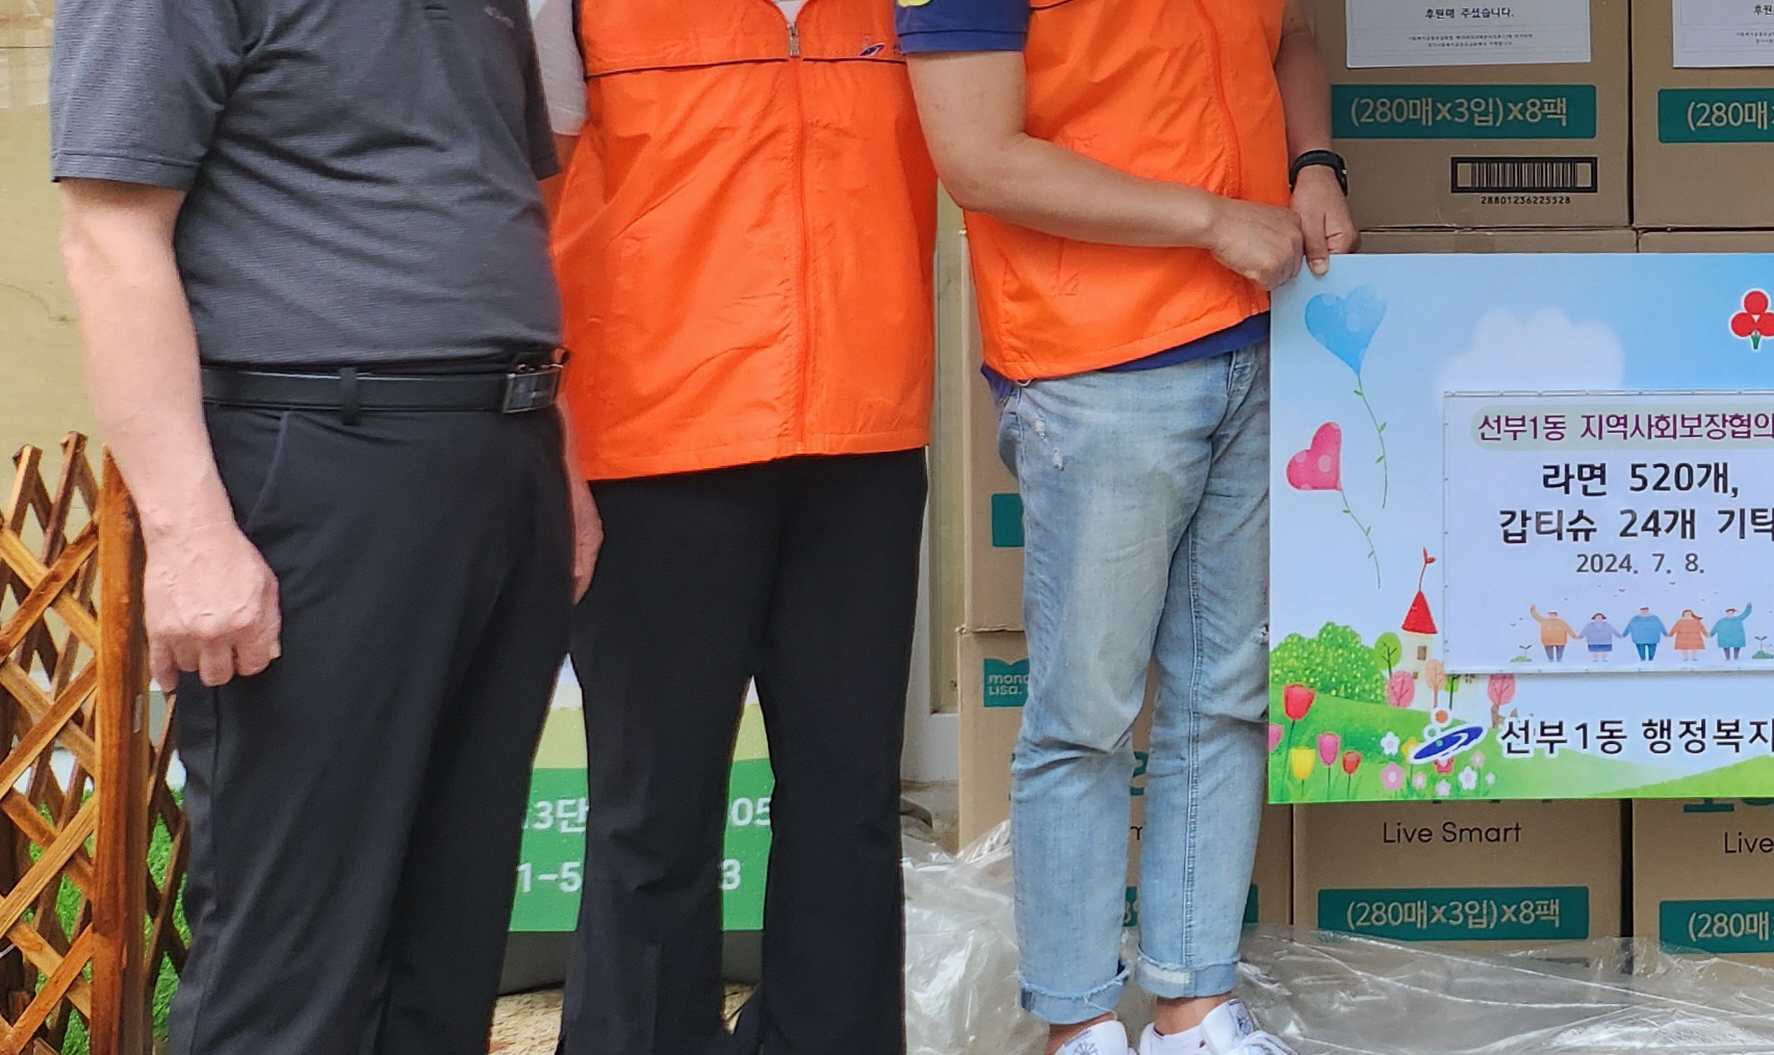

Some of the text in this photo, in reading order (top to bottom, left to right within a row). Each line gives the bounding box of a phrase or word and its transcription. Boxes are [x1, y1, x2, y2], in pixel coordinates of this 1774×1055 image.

[1478, 414, 1566, 441] 선부1동
[1542, 461, 1739, 498] 라면 520개,
[1500, 509, 1597, 544] 갑티슈
[1619, 509, 1696, 540] 24개
[1576, 552, 1705, 574] 2024. 7. 8.
[1501, 719, 1628, 755] 선부1동
[521, 798, 590, 834] 3단
[1383, 821, 1522, 843] Live Smart
[1725, 832, 1774, 854] Live
